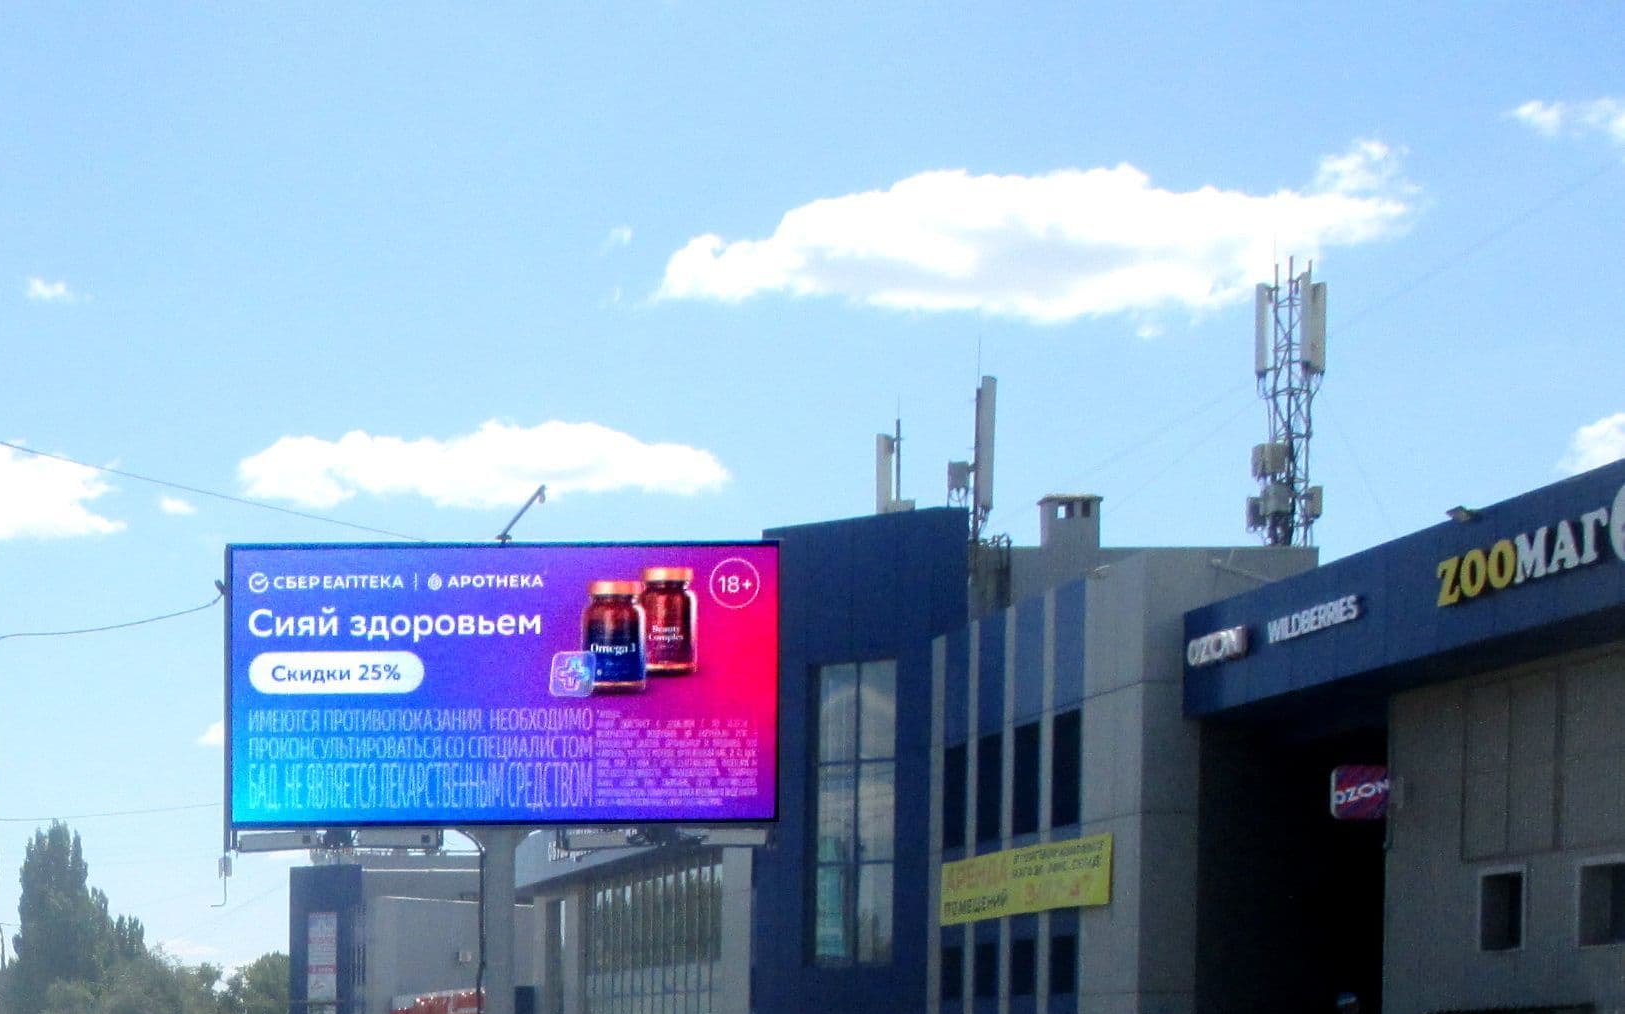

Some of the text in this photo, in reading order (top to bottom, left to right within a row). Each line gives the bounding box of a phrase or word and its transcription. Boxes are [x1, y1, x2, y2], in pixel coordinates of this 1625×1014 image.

[447, 574, 544, 588] APOTHEKA
[717, 575, 752, 593] 18+
[248, 606, 541, 643] Сияй здоровьем
[1267, 594, 1359, 644] WILDBERRIES
[590, 643, 629, 656] Omega
[1187, 625, 1246, 667] OZON
[271, 664, 401, 683] Скидки 25%
[248, 709, 320, 732] ИМЕЮТСЯ
[490, 708, 593, 731] НЕОБХОДИМО
[248, 735, 593, 760] ПРОКОНСУЛЬТИРОВАТЬСЯ СО СПЕЦИАЛИСТОМ
[285, 763, 303, 809] НЕ
[508, 761, 593, 811] СРЕДСТВОМ
[1333, 779, 1389, 805] OZON
